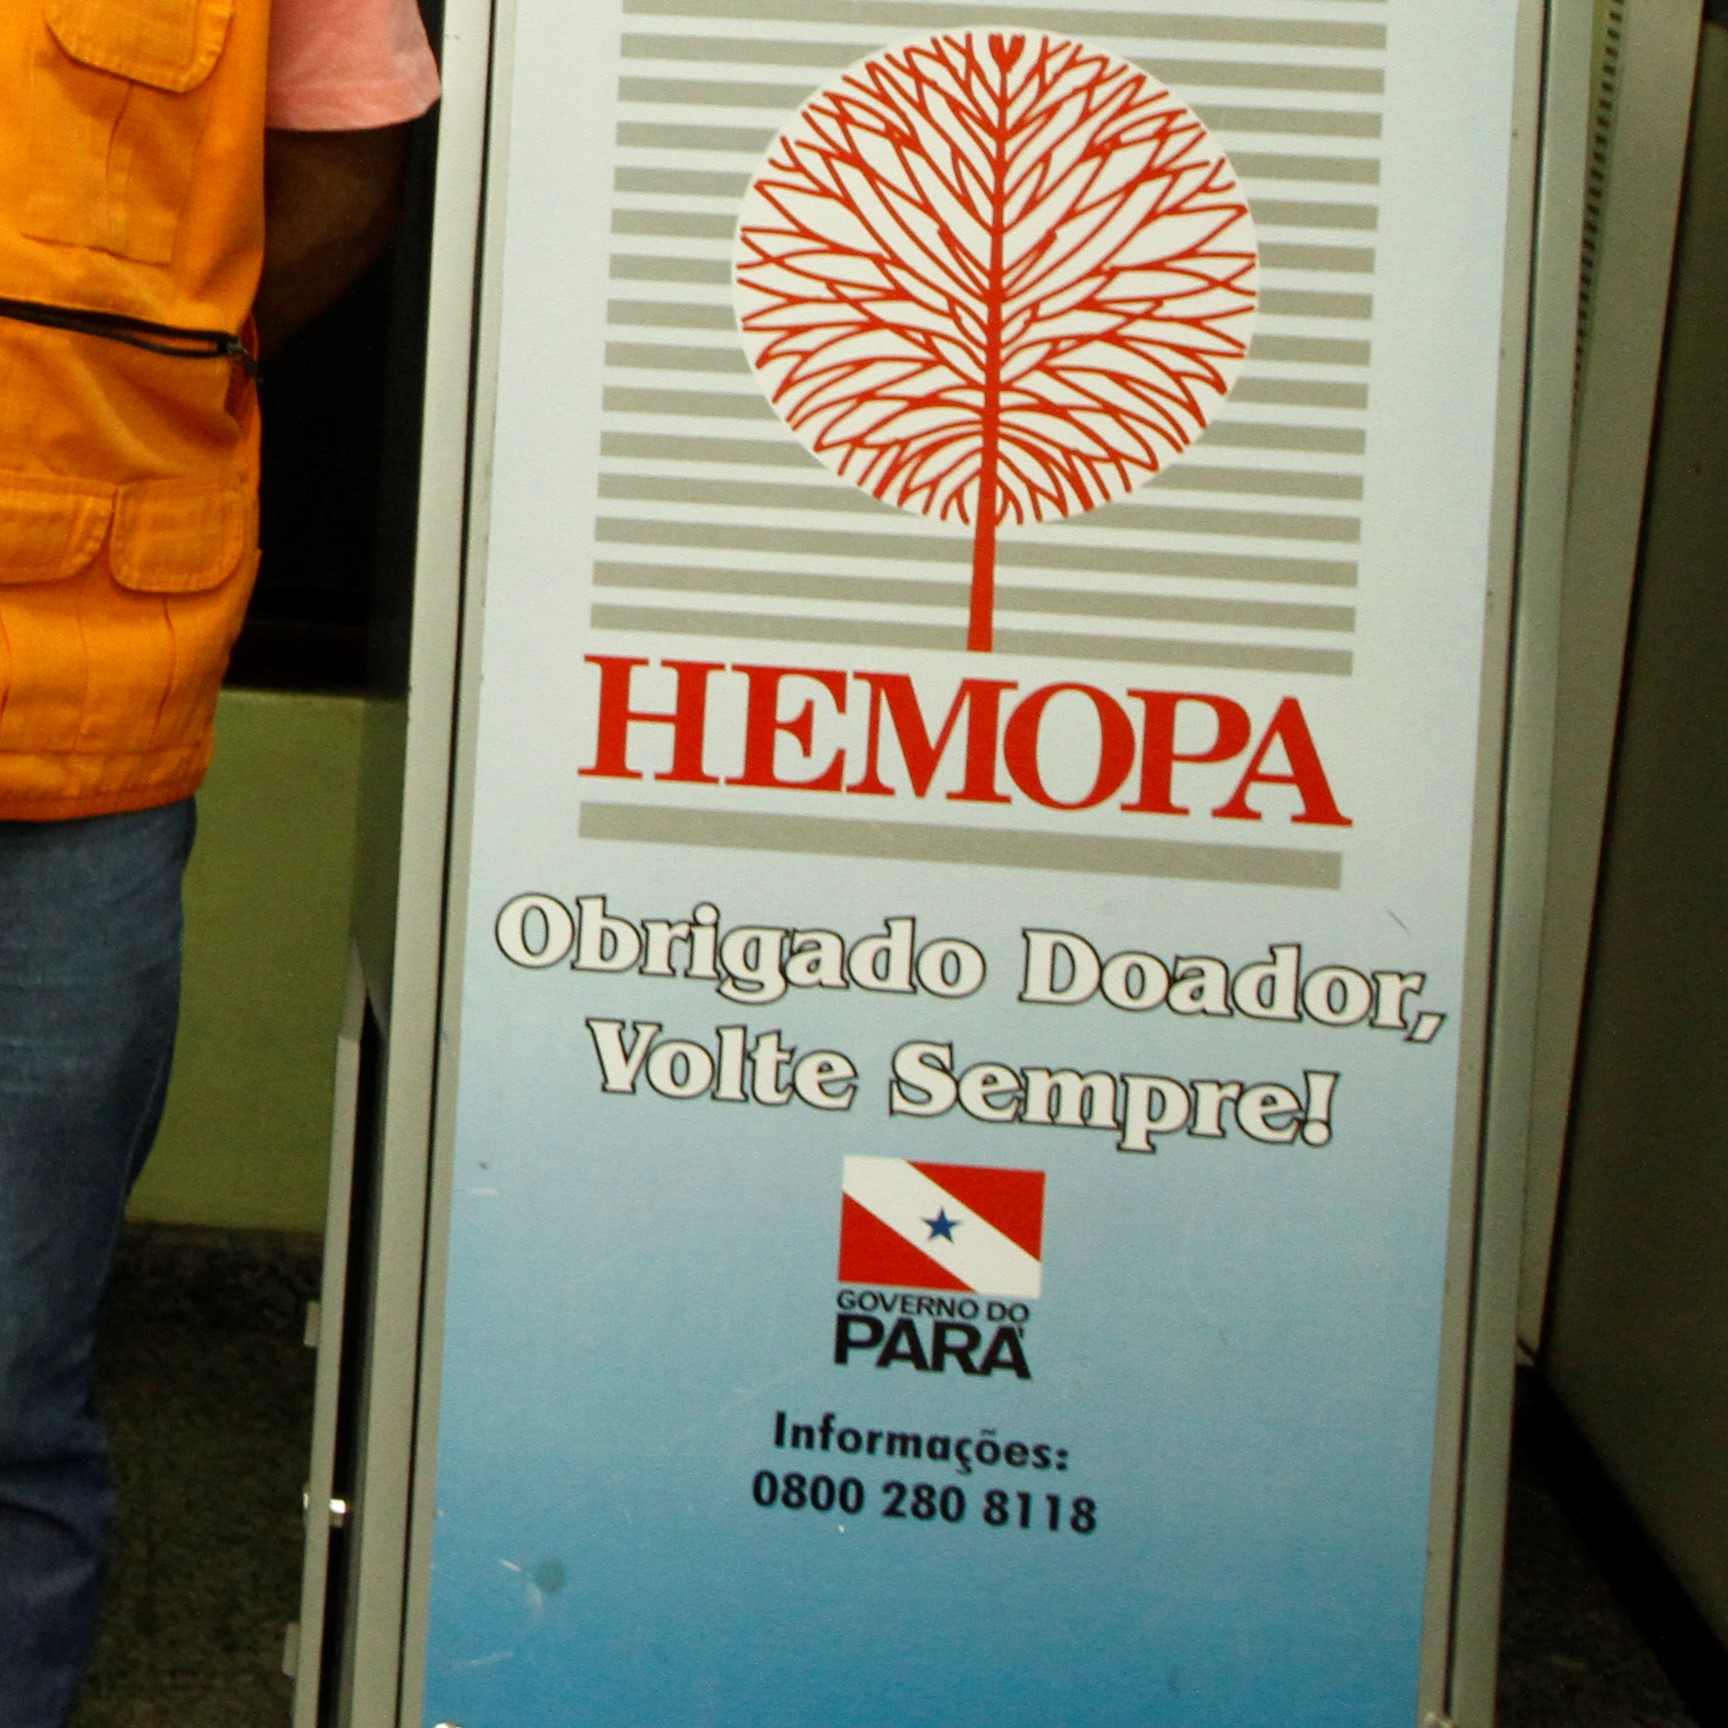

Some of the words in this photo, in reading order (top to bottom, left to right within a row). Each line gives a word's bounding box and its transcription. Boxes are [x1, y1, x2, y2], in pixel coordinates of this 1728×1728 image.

[578, 652, 1352, 828] HEMOPA
[495, 892, 987, 1004] Obrigado
[1019, 927, 1448, 1042] Doador,
[586, 1018, 858, 1111] Volte
[889, 1040, 1339, 1154] Sempre!
[836, 1288, 979, 1319] GOVERNO
[987, 1300, 1030, 1323] DO
[833, 1312, 1032, 1380] PARÁ
[773, 1410, 1069, 1474] Informações:
[752, 1469, 865, 1515] 0800
[882, 1480, 966, 1523] 280
[982, 1488, 1097, 1534] 8118
